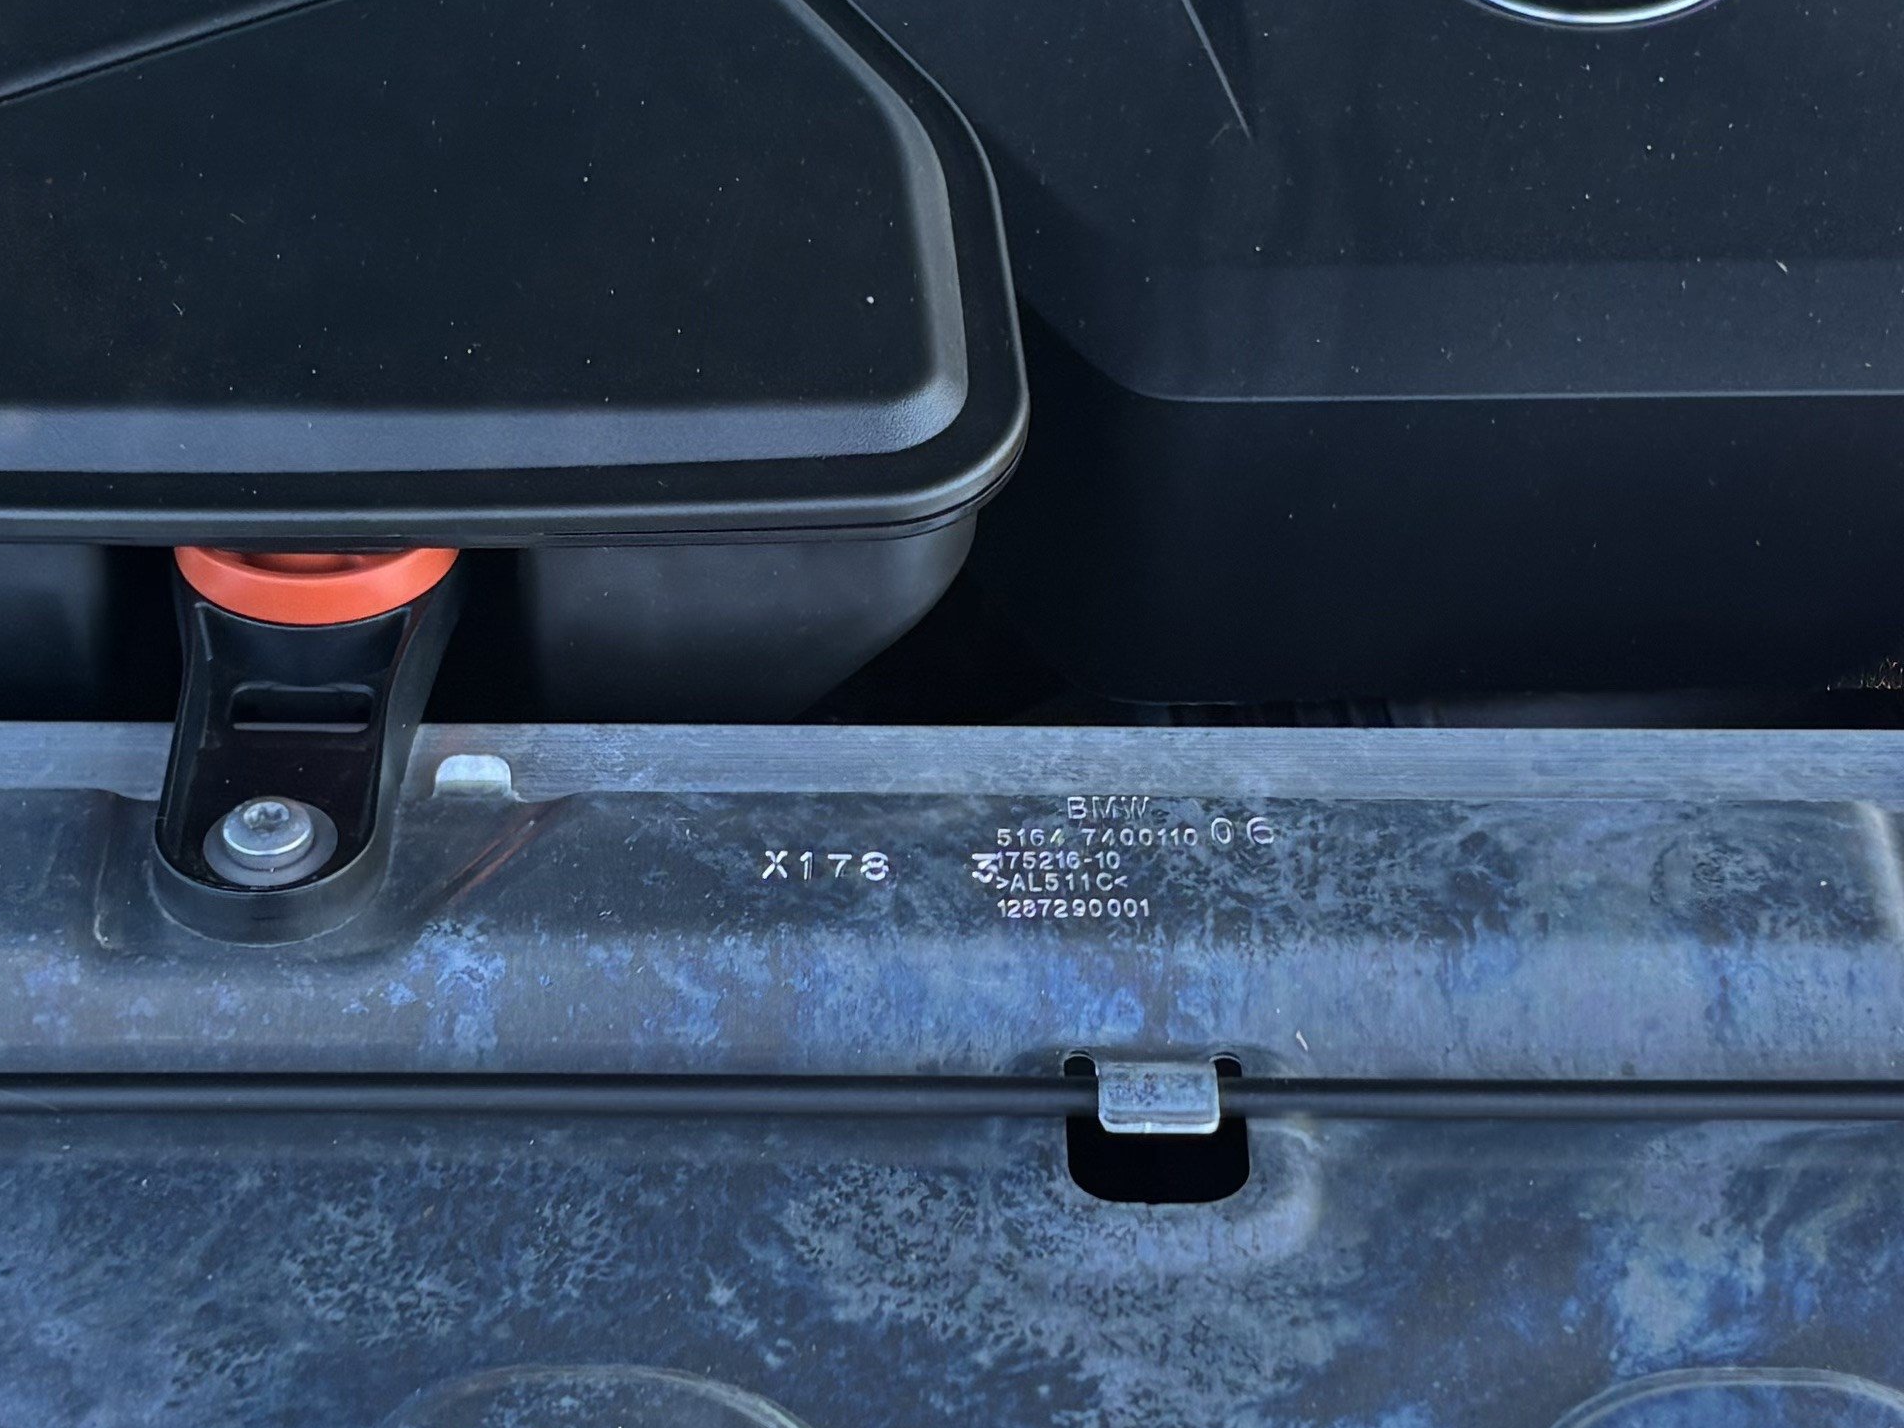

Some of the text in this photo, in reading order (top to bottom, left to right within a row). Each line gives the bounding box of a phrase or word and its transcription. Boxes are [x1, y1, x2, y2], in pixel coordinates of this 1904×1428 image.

[1067, 796, 1150, 820] BMW
[997, 828, 1065, 847] 5164
[761, 850, 890, 881] X178
